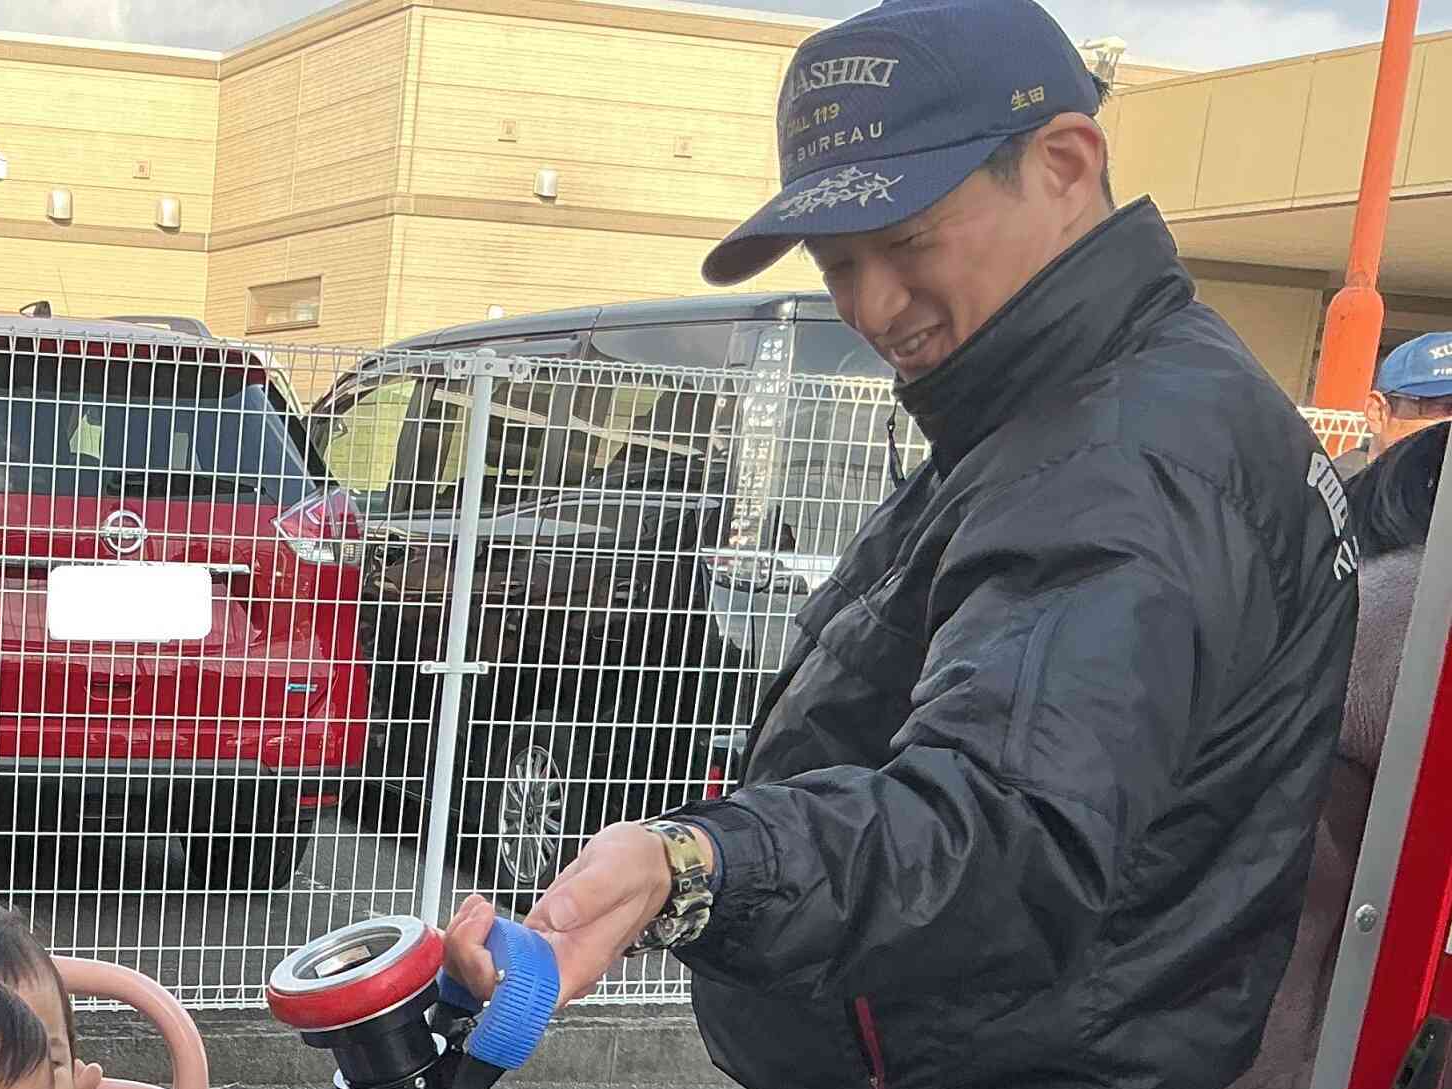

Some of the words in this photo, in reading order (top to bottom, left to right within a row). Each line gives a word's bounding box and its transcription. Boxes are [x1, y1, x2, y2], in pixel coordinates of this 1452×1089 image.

[1011, 86, 1044, 111] 生田
[812, 102, 840, 125] 119
[796, 120, 883, 162] BUREAU
